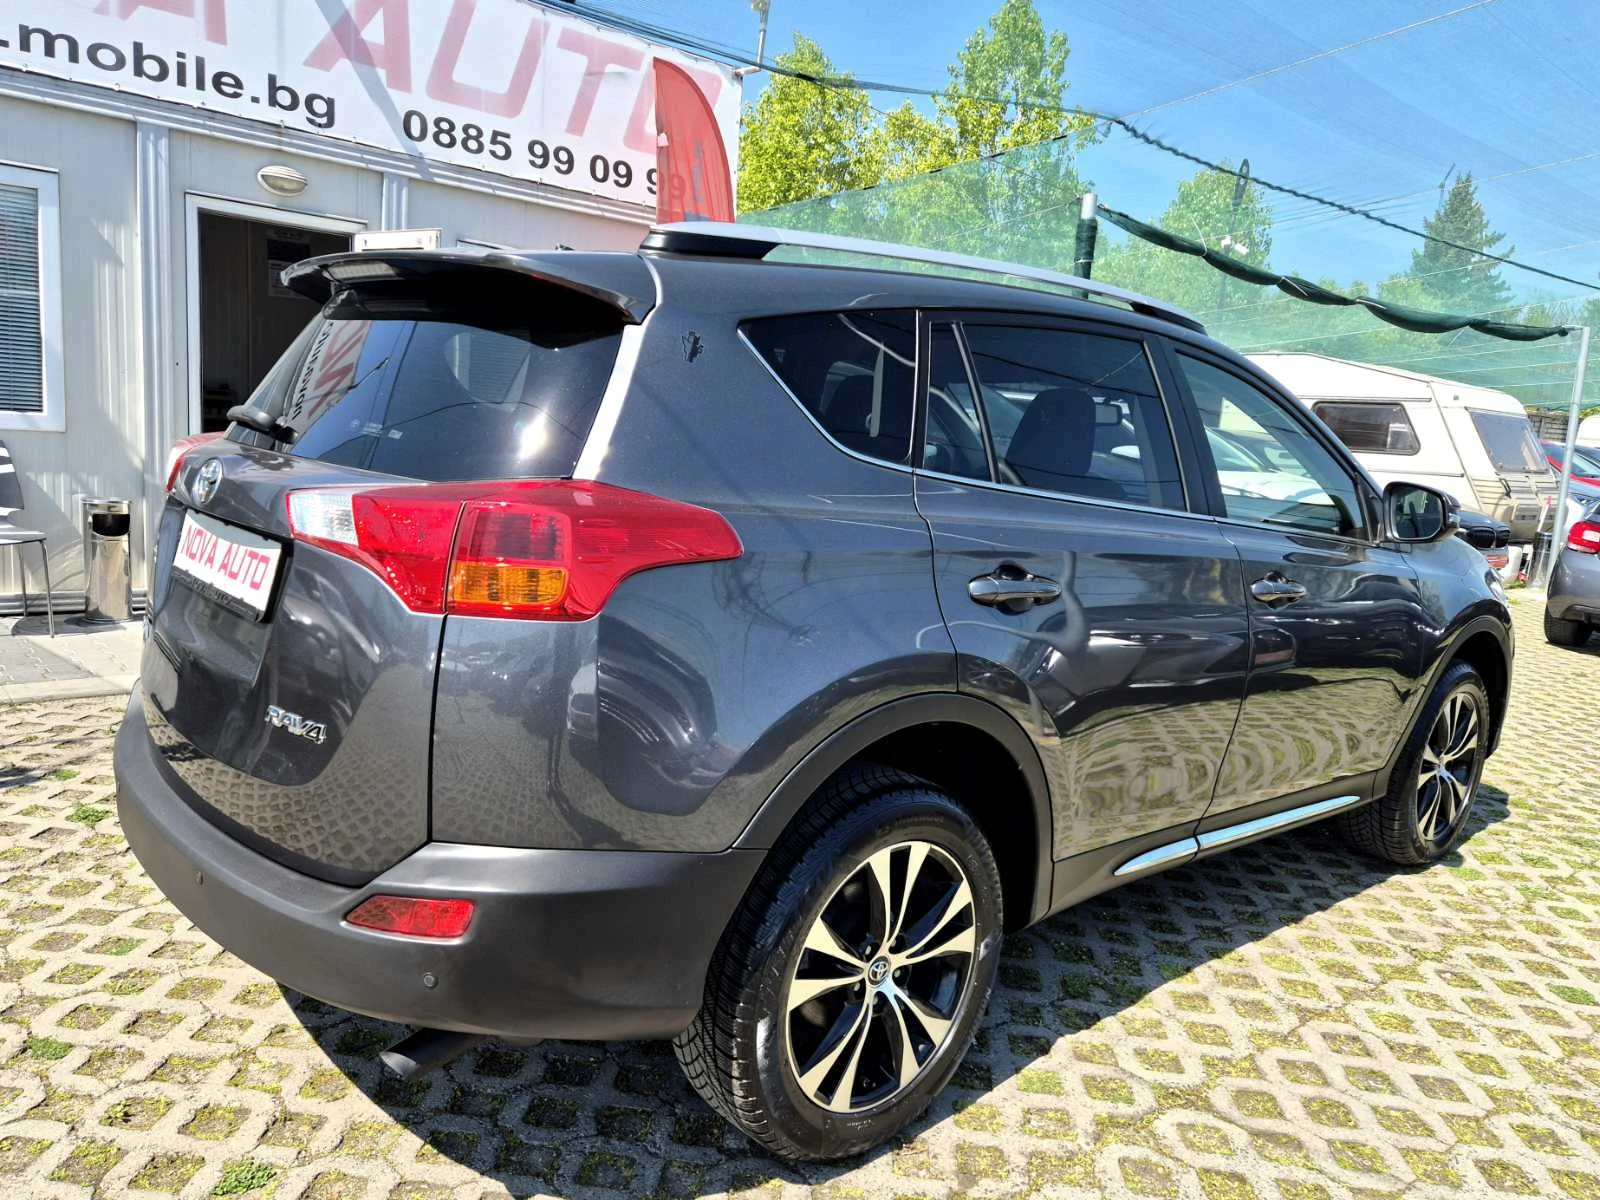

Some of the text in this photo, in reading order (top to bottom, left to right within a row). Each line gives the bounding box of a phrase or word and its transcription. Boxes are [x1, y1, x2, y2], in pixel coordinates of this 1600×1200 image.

[403, 109, 513, 161] 0885
[528, 139, 575, 175] 99
[590, 155, 633, 189] 09
[181, 524, 271, 591] NOVA AUTO
[264, 705, 327, 744] RAV4
